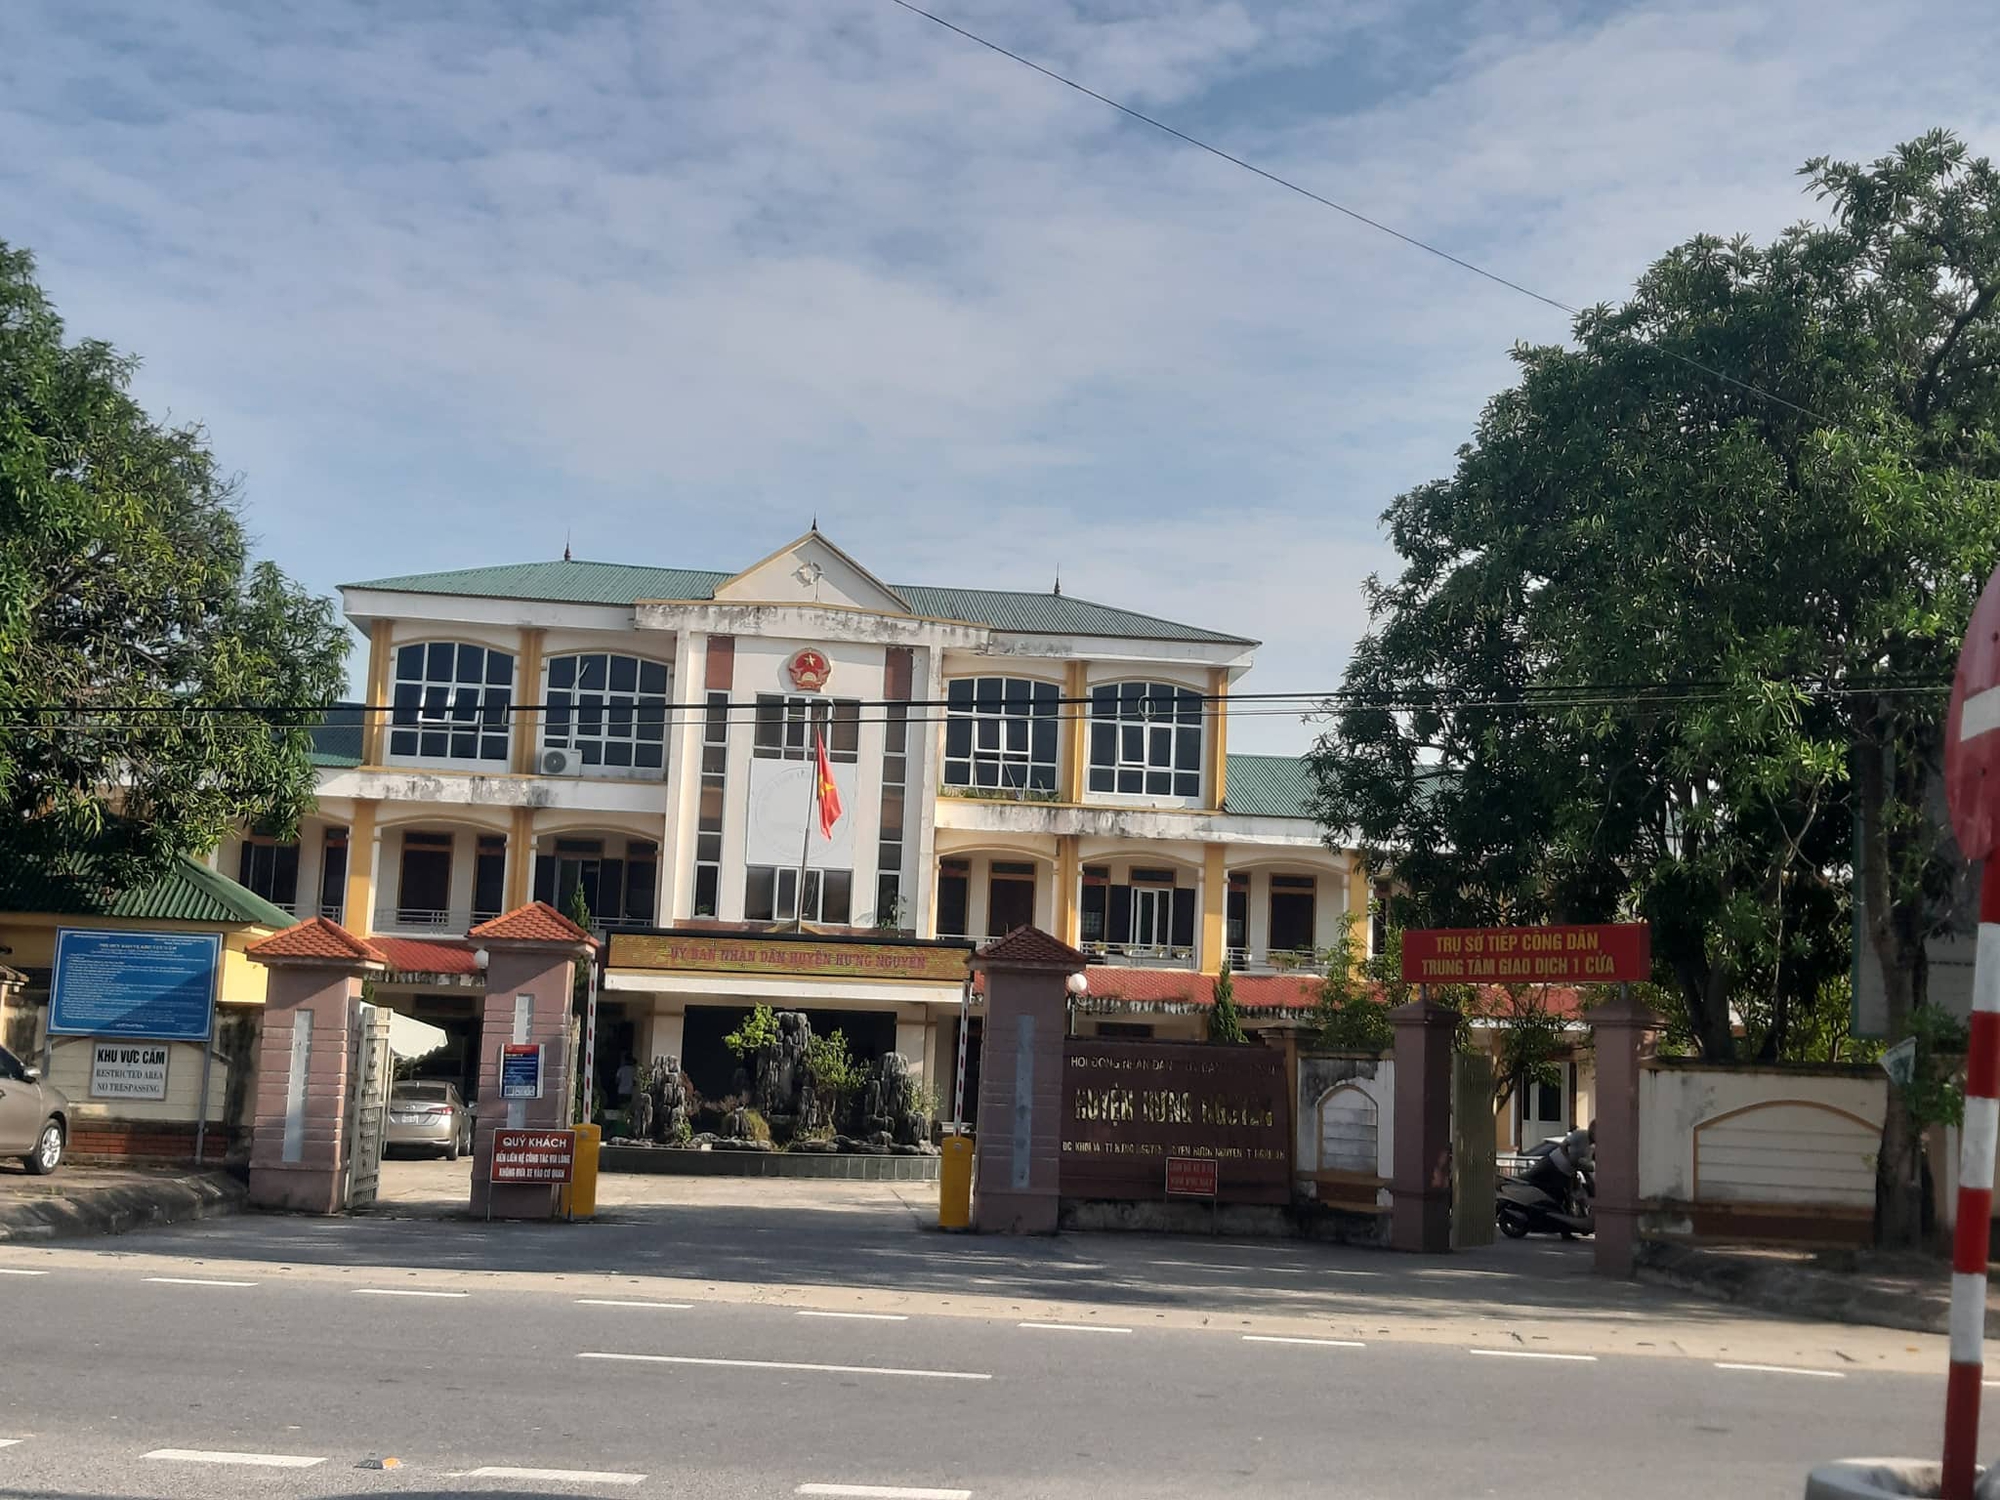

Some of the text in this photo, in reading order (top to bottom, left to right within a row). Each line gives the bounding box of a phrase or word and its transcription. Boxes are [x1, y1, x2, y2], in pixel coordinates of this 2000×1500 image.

[1436, 929, 1598, 955] TRỤ SỞ TIẾP CÔNG DÂN
[1422, 959, 1463, 976] TRUNG
[1467, 955, 1495, 975] TÂM
[1499, 958, 1530, 975] GIAO
[1535, 957, 1567, 977] DỊCH
[1573, 958, 1579, 974] 1
[97, 1047, 165, 1067] KHU VỰC CẤM
[96, 1069, 163, 1080] RESTRICTED AREA
[96, 1083, 160, 1093] NO TRESPASSING
[503, 1134, 567, 1148] QUÝ KHÁCH
